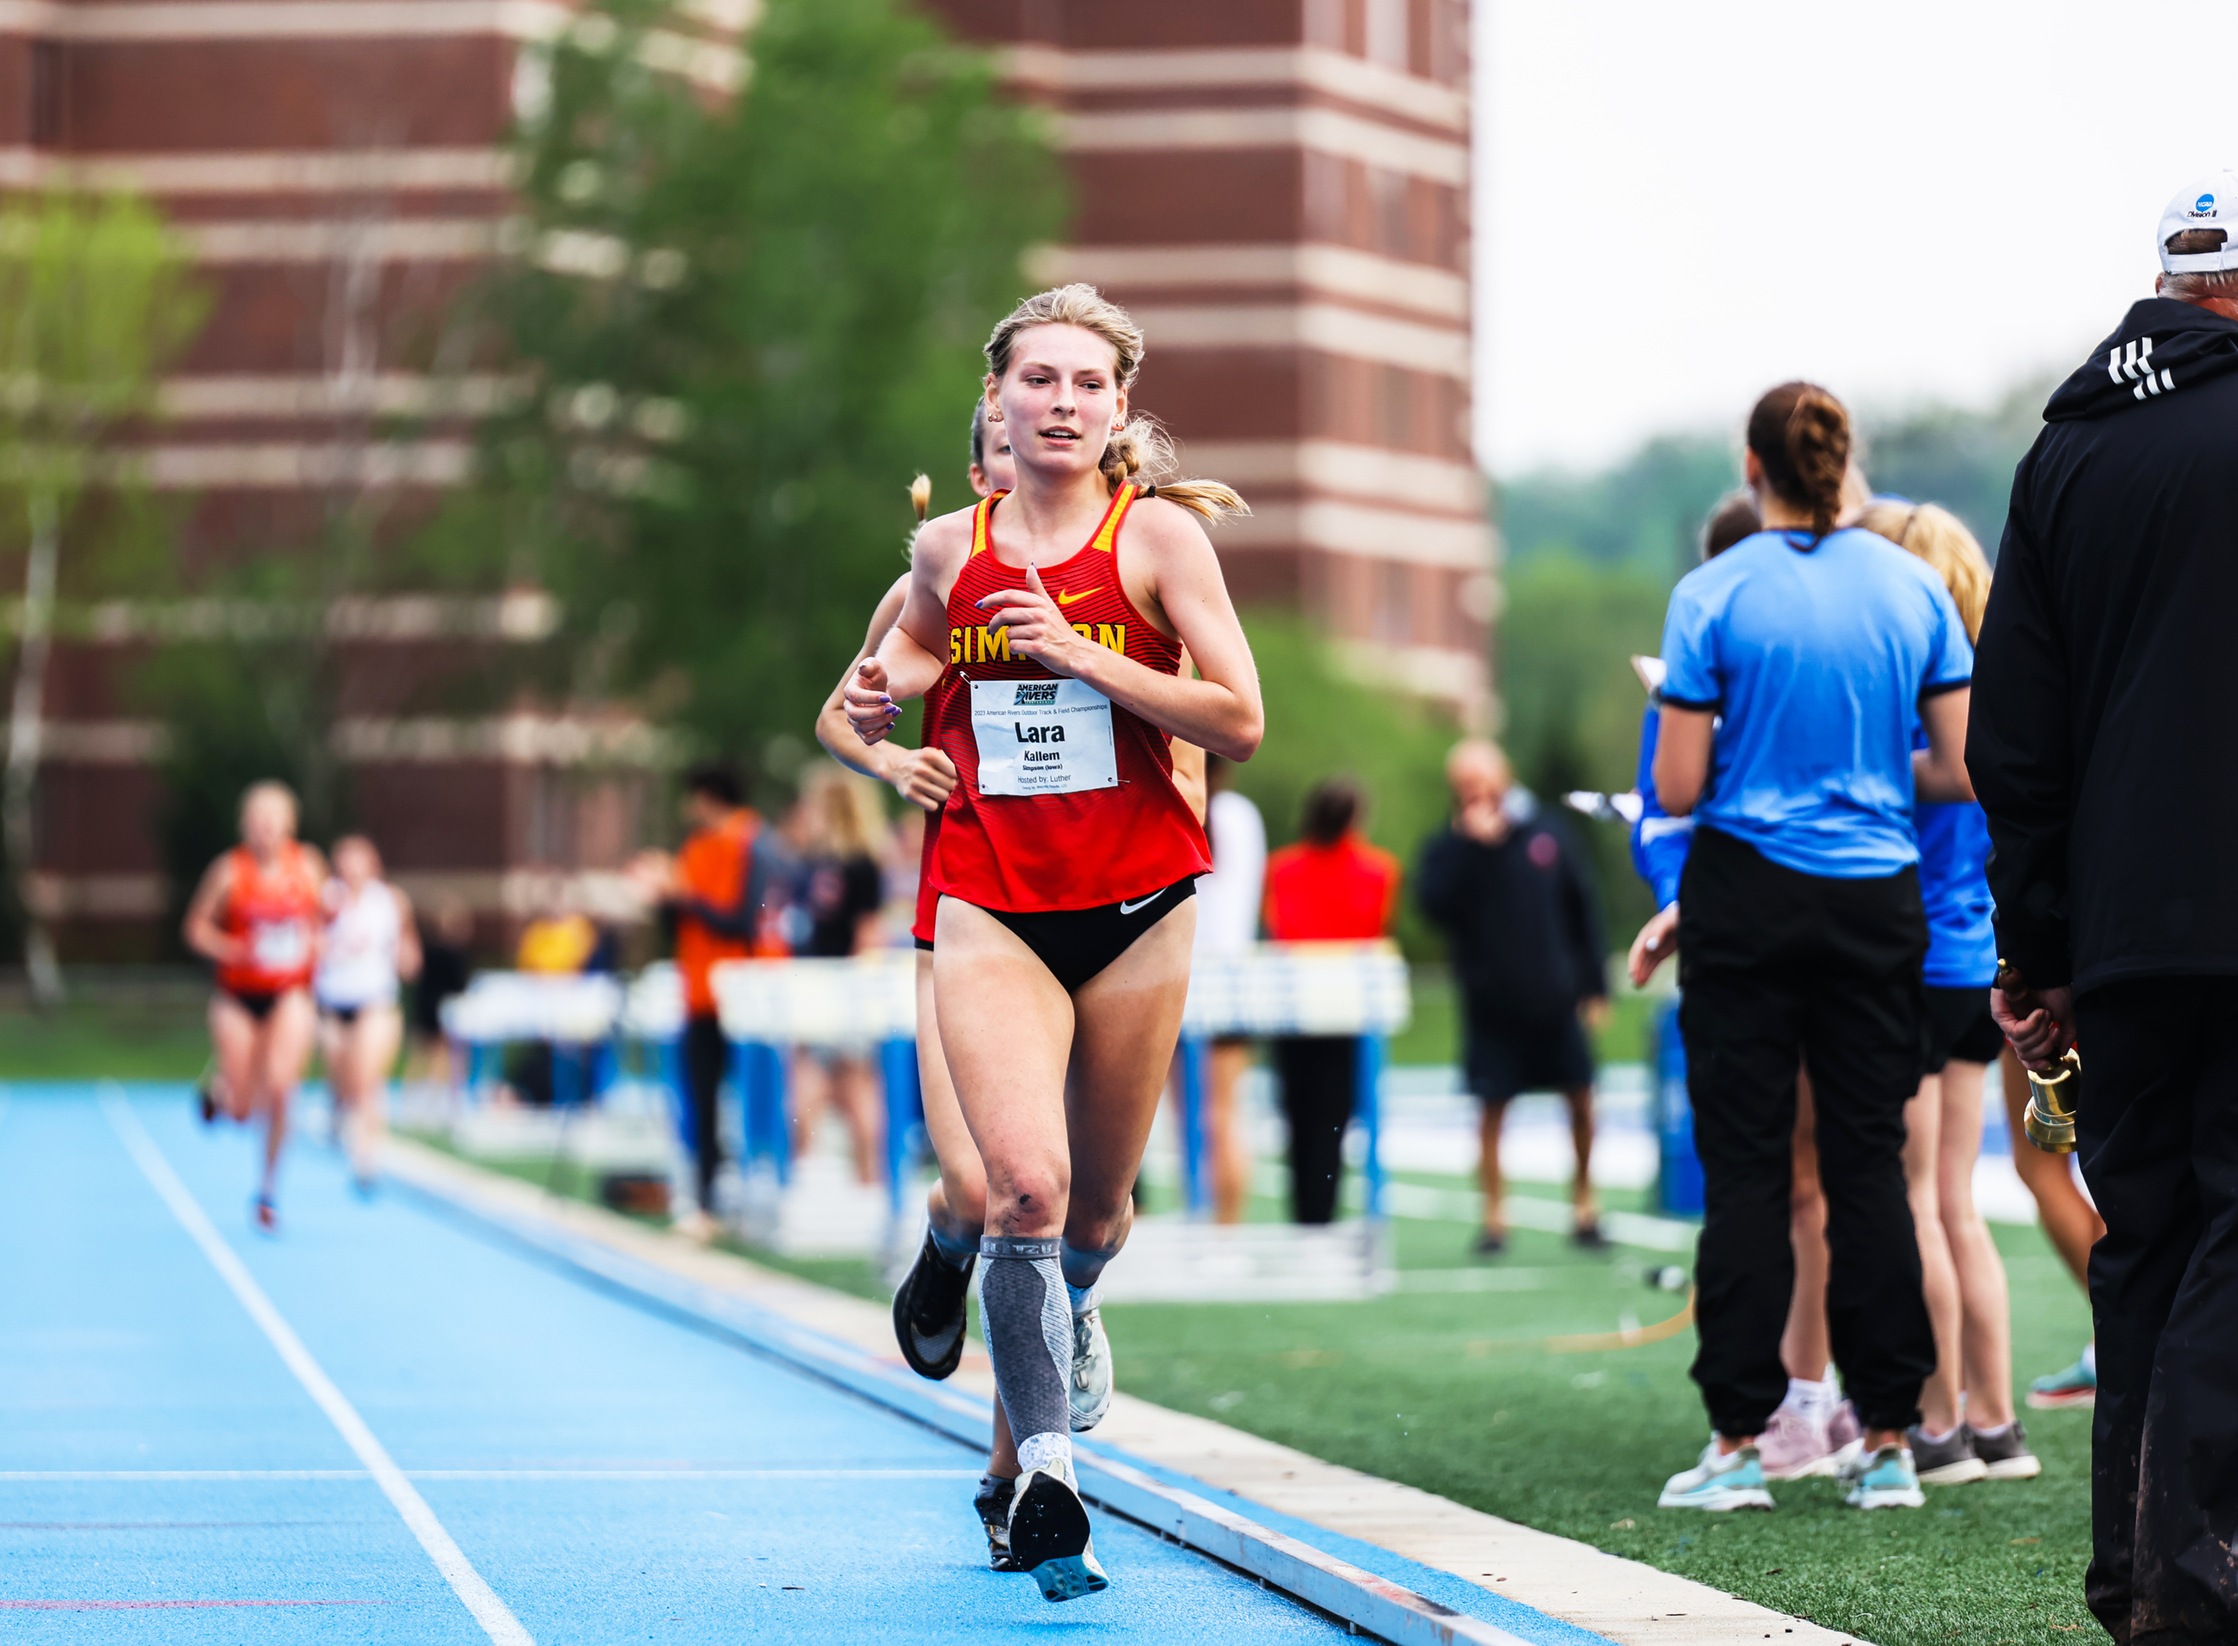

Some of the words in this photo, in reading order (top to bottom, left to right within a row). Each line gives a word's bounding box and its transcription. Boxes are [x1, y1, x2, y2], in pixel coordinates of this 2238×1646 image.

[950, 623, 1126, 664] SIMN
[1017, 683, 1058, 691] AMERICAN
[1015, 691, 1056, 702] RIVERS
[1071, 704, 1108, 712] Championships
[1015, 722, 1065, 743] Lara
[1024, 750, 1060, 761] Kallem
[1022, 764, 1044, 772] Simpson
[1045, 763, 1063, 771] (Iowa)
[1018, 776, 1037, 784] Hosted
[1050, 774, 1071, 782] Luther
